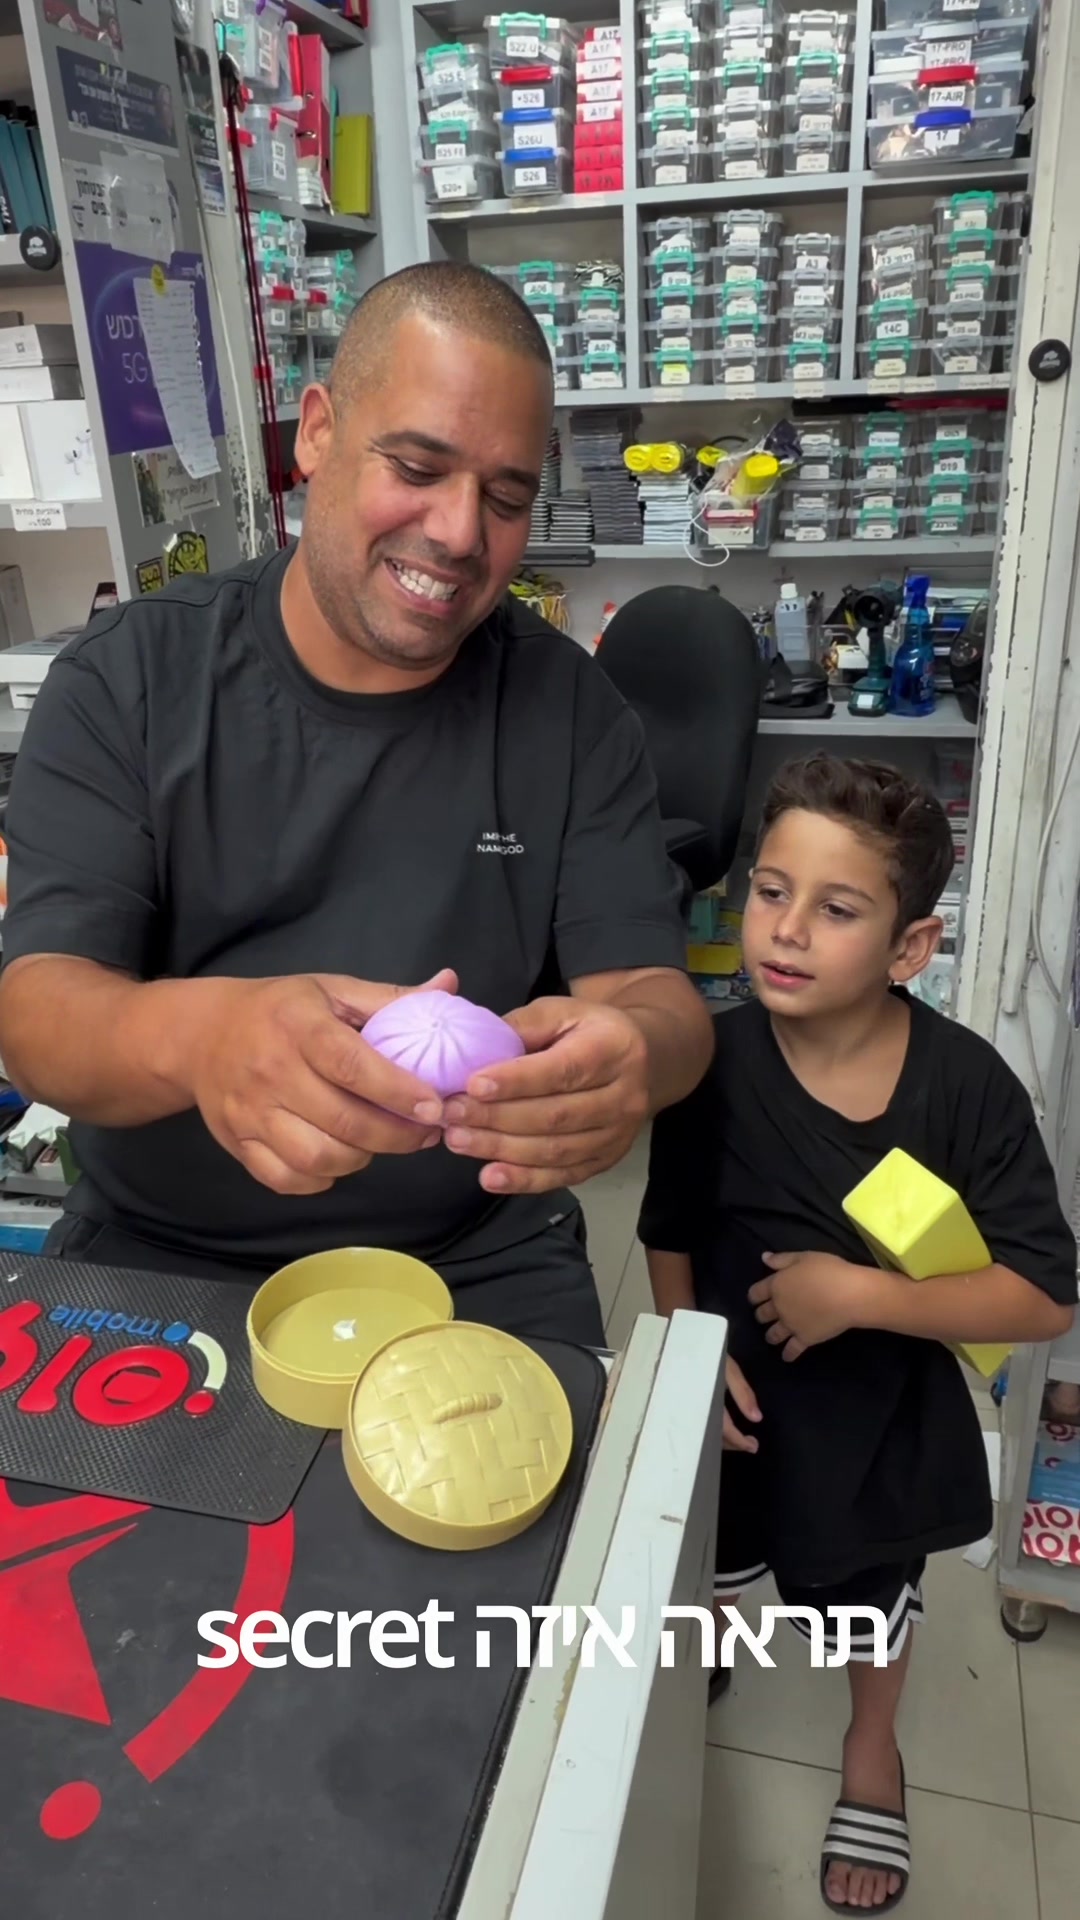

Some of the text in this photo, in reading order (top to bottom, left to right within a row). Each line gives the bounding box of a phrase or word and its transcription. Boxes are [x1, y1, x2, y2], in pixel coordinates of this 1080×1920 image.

[931, 41, 966, 51] 17-PRO
[930, 91, 963, 102] 17-AIR
[518, 135, 543, 145] S26U
[936, 131, 948, 141] 17
[522, 171, 540, 181] S26
[805, 259, 819, 269] A3
[884, 323, 903, 335] 14C
[122, 351, 148, 384] 5G
[49, 1304, 162, 1339] mobile
